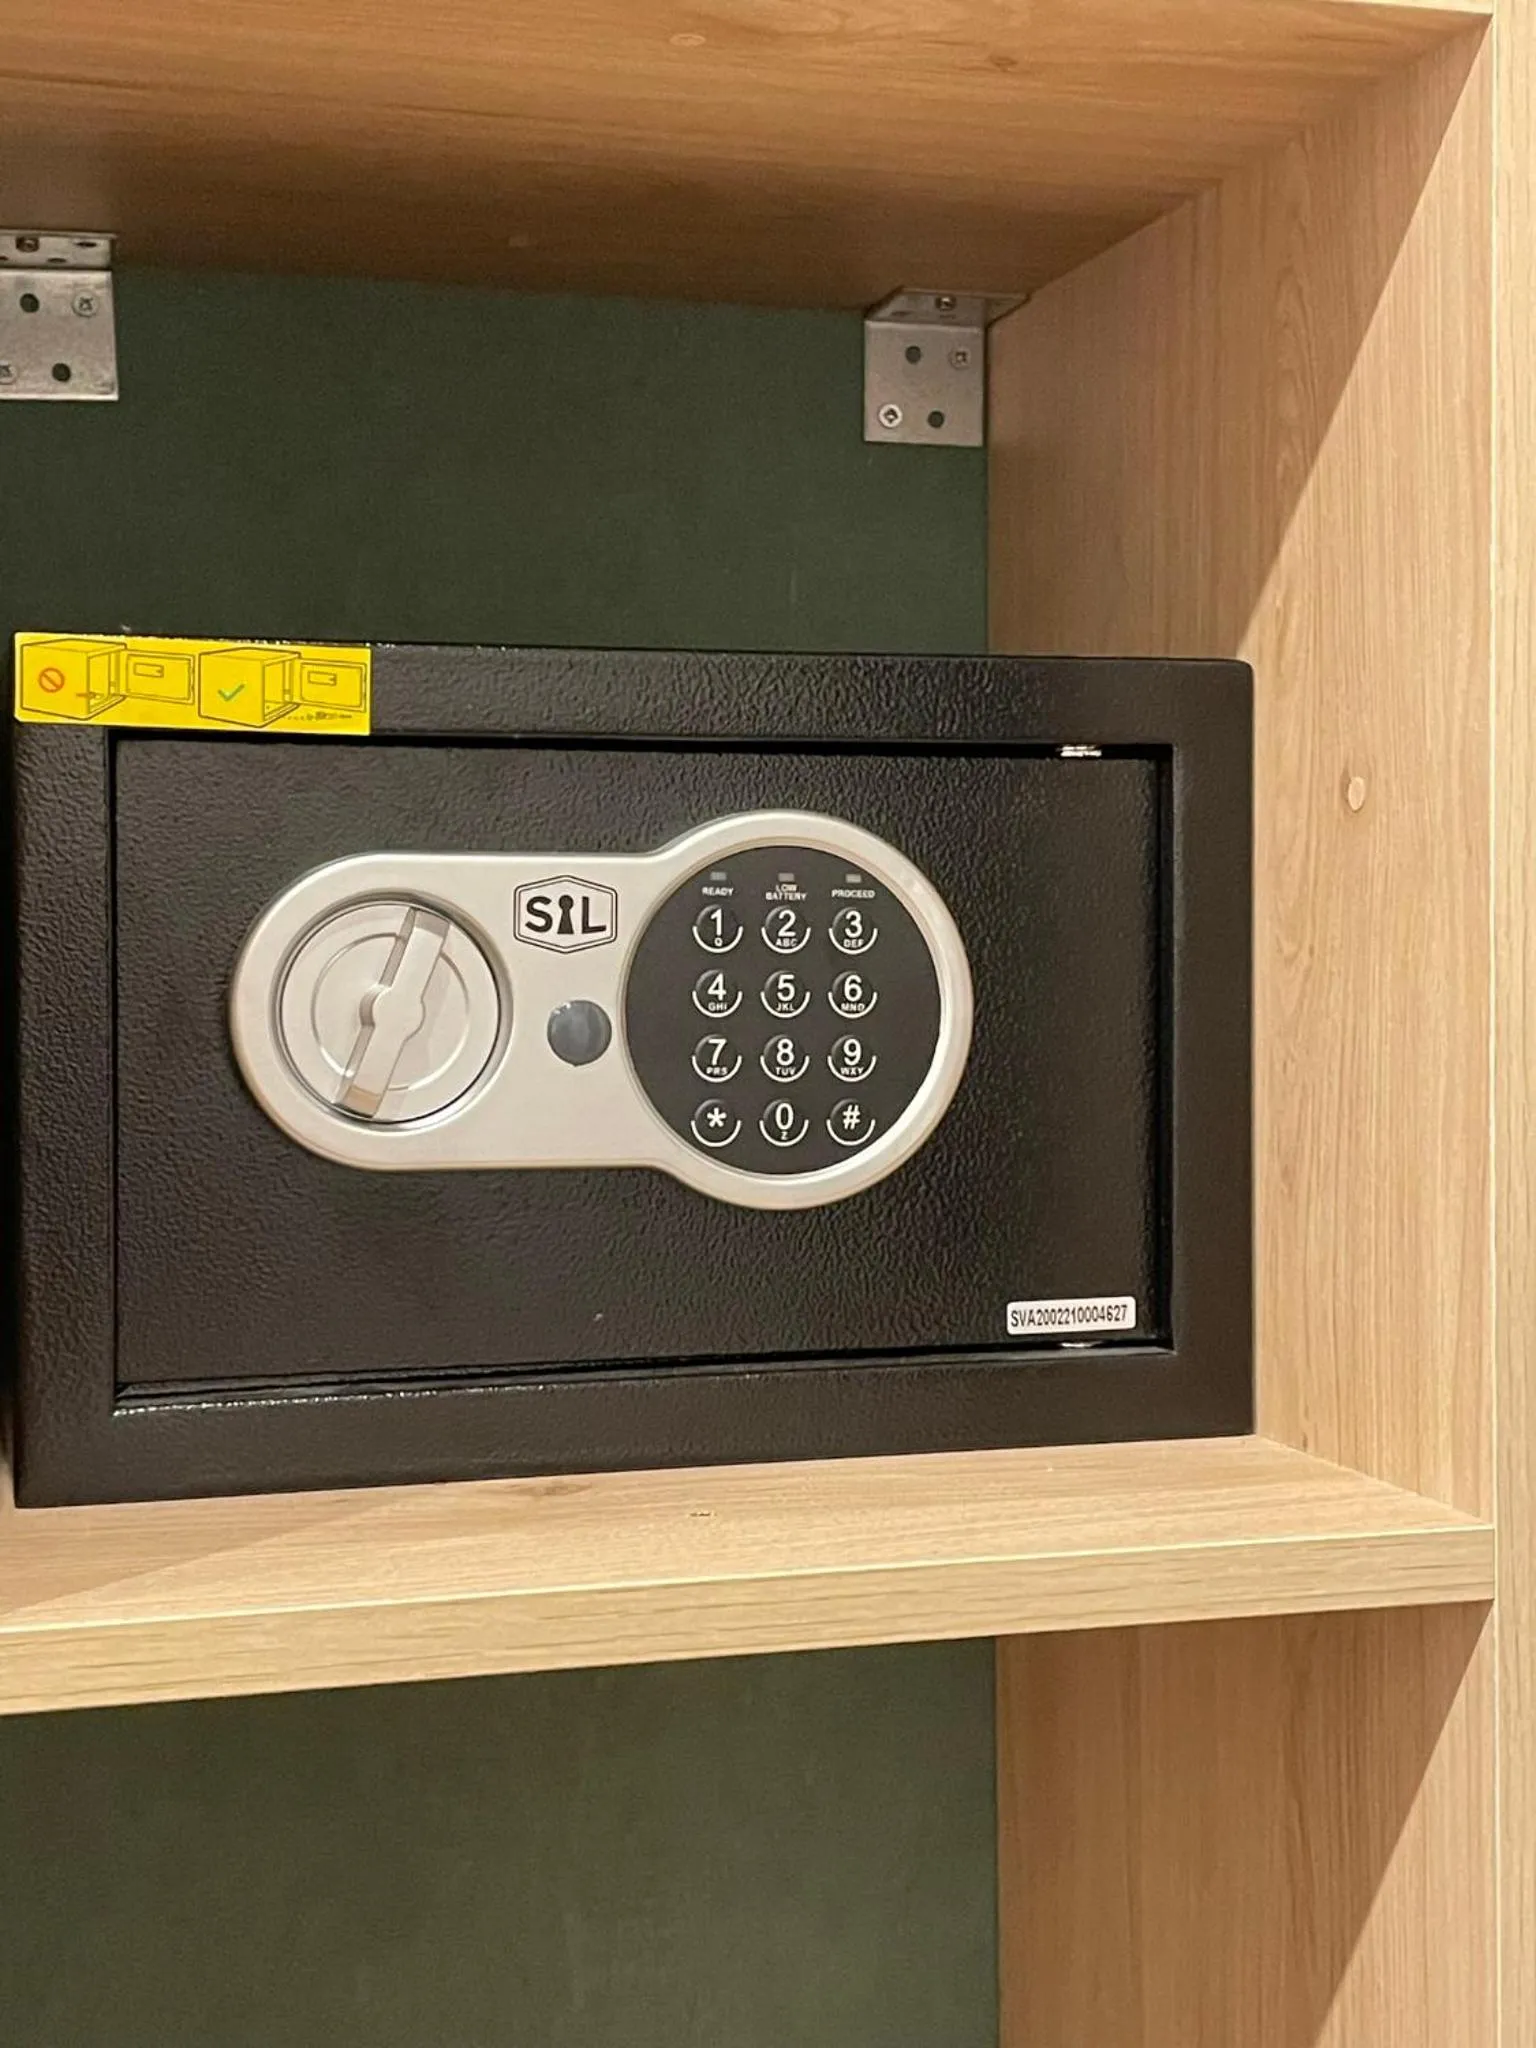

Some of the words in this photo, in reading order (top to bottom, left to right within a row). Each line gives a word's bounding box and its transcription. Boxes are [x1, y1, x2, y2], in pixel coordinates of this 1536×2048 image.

[702, 887, 734, 897] READY
[765, 892, 807, 900] BATTERY
[776, 884, 797, 892] LOW
[831, 889, 875, 898] PROCEED
[710, 908, 722, 936] 1
[778, 909, 796, 937] 2
[845, 911, 862, 938] 3
[775, 938, 798, 947] ABC
[843, 939, 864, 948] DEF
[707, 972, 727, 1000] 4
[777, 974, 795, 1001] 5
[844, 974, 862, 1002] 6
[708, 1002, 727, 1011] GHI
[776, 1003, 795, 1011] JKL
[841, 1003, 865, 1012] MNO
[708, 1038, 727, 1066] 7
[776, 1038, 794, 1066] 8
[843, 1039, 861, 1066] 9
[775, 1067, 796, 1076] TUV
[840, 1067, 864, 1075] WXY
[775, 1103, 794, 1130] 0
[842, 1105, 860, 1130] #
[781, 1131, 788, 1140] Z
[1011, 1304, 1128, 1328] SVA2002210004627
